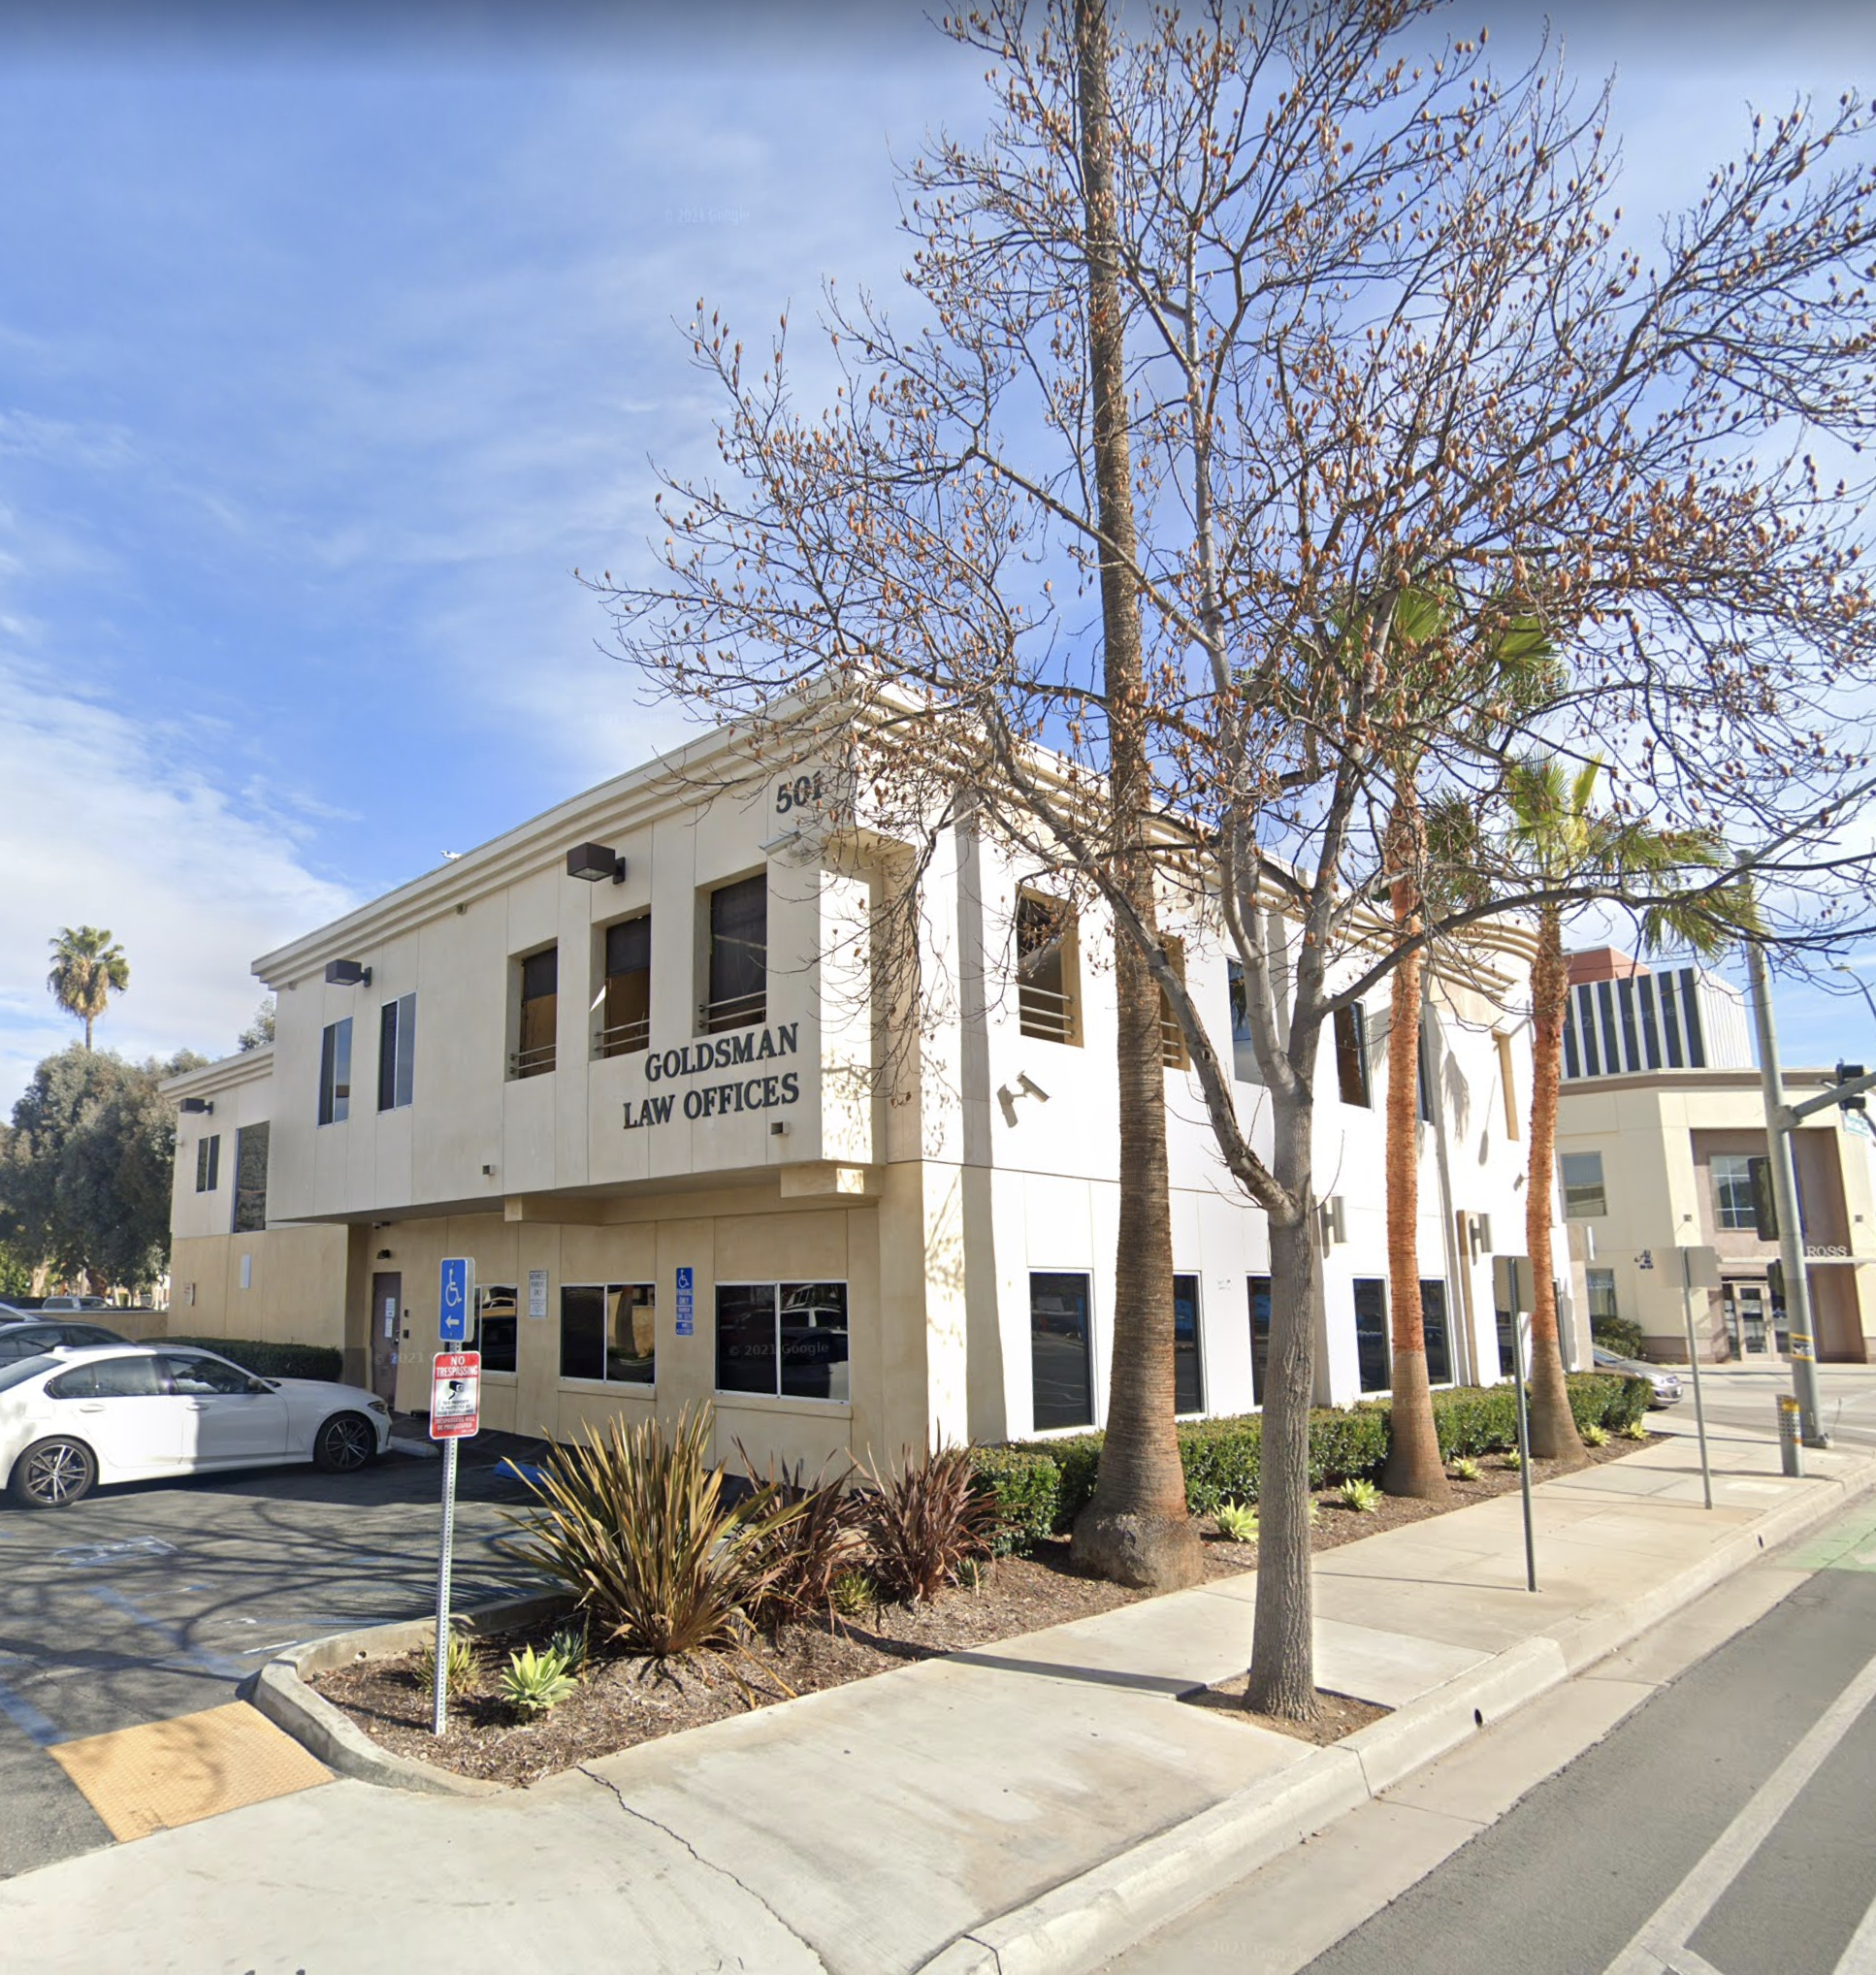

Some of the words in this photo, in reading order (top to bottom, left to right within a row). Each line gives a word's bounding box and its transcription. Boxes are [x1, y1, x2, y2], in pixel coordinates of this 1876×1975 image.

[776, 770, 823, 814] 501
[645, 1022, 798, 1083] GOLDSMAN
[623, 1094, 676, 1129] LAW
[683, 1072, 799, 1119] OFFICES
[1806, 1246, 1848, 1257] ROSS
[437, 1365, 478, 1377] TRESPASSING
[450, 1356, 466, 1366] NO
